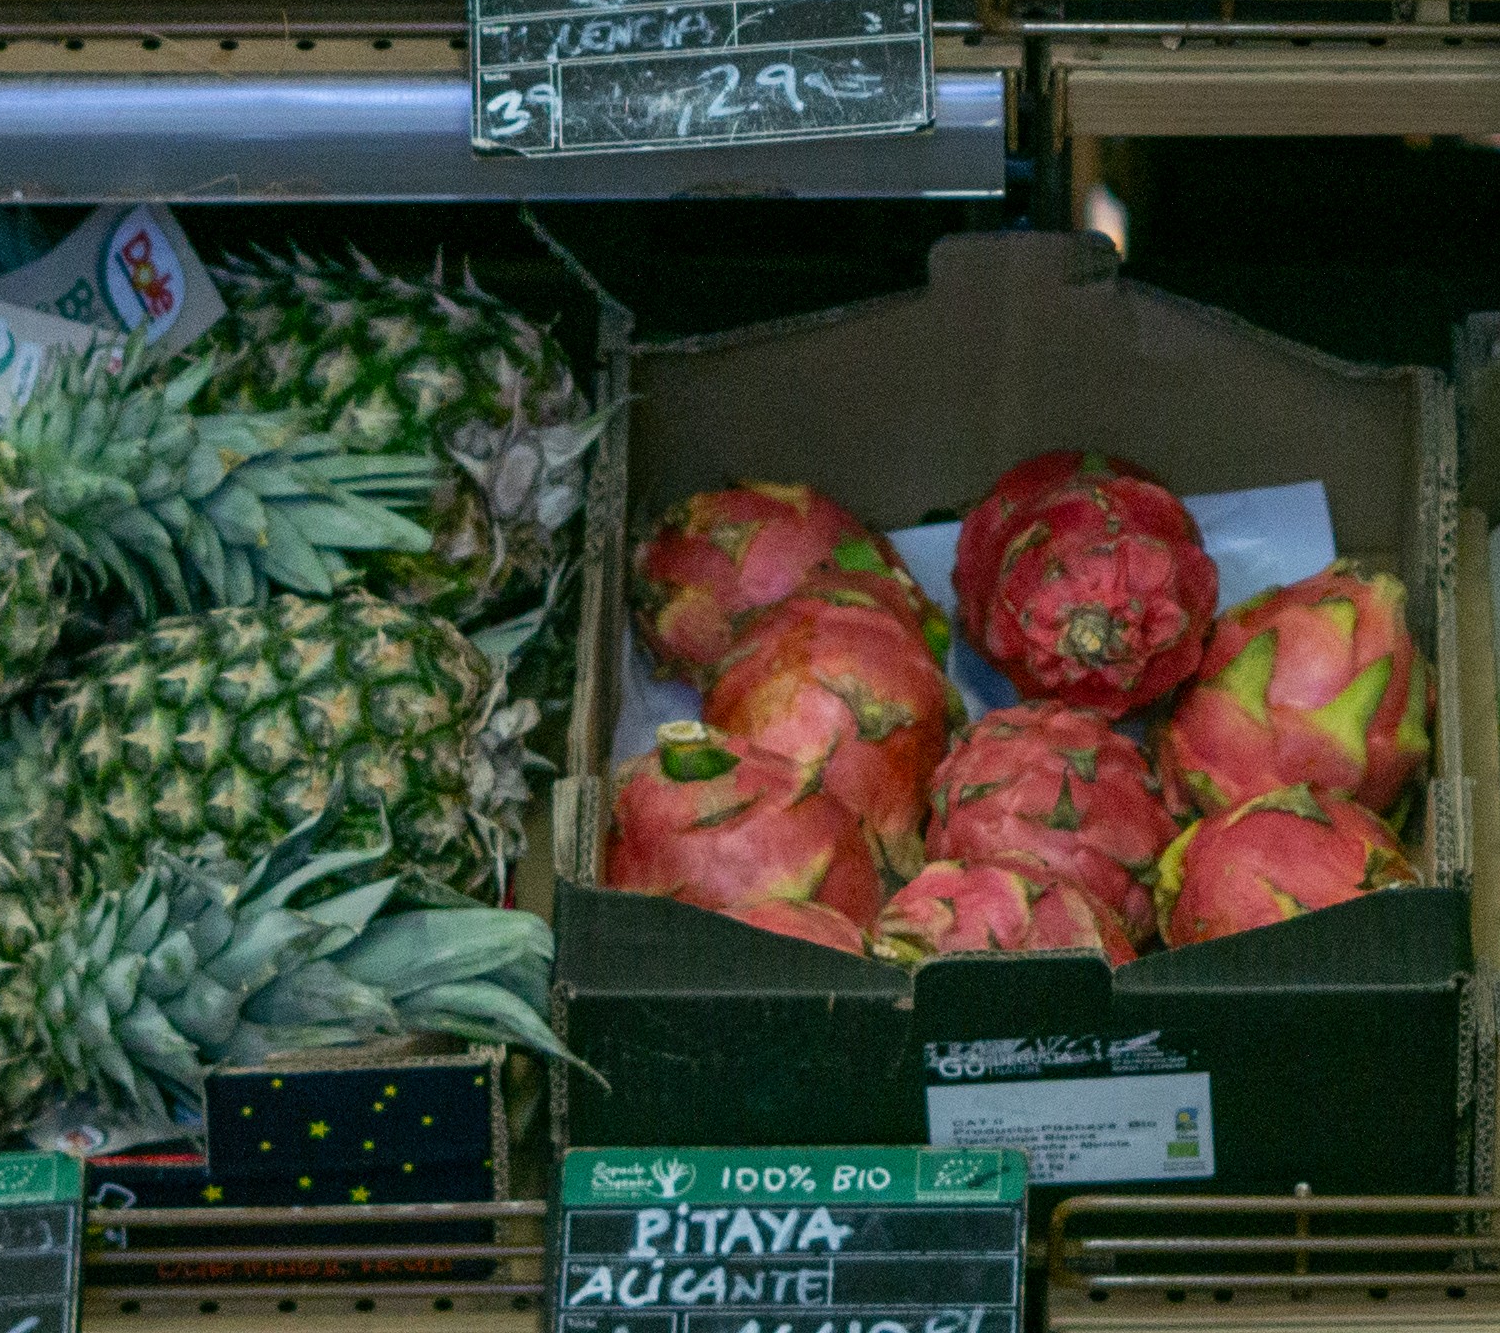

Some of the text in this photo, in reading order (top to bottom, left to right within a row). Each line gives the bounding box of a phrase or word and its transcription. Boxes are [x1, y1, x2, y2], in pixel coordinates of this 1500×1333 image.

[121, 230, 174, 319] Dole
[721, 1164, 892, 1193] 100% BIO
